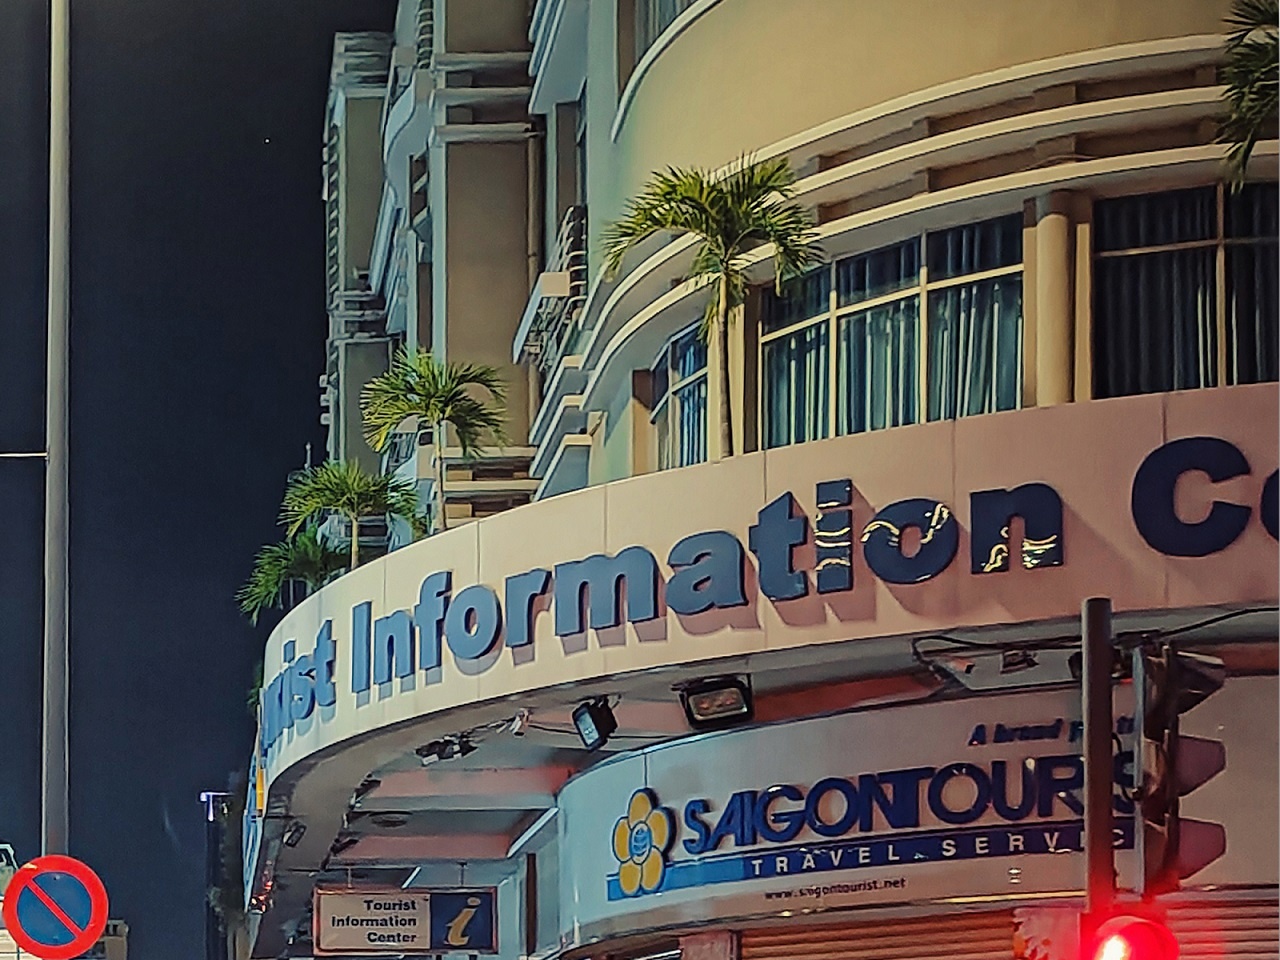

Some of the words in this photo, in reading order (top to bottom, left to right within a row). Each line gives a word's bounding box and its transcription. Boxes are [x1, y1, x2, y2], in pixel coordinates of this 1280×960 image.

[351, 479, 1064, 694] Information
[1131, 435, 1279, 558] C
[751, 845, 901, 875] TRAVEL
[363, 899, 417, 911] Tourist
[331, 915, 417, 928] Information
[366, 931, 417, 943] Center
